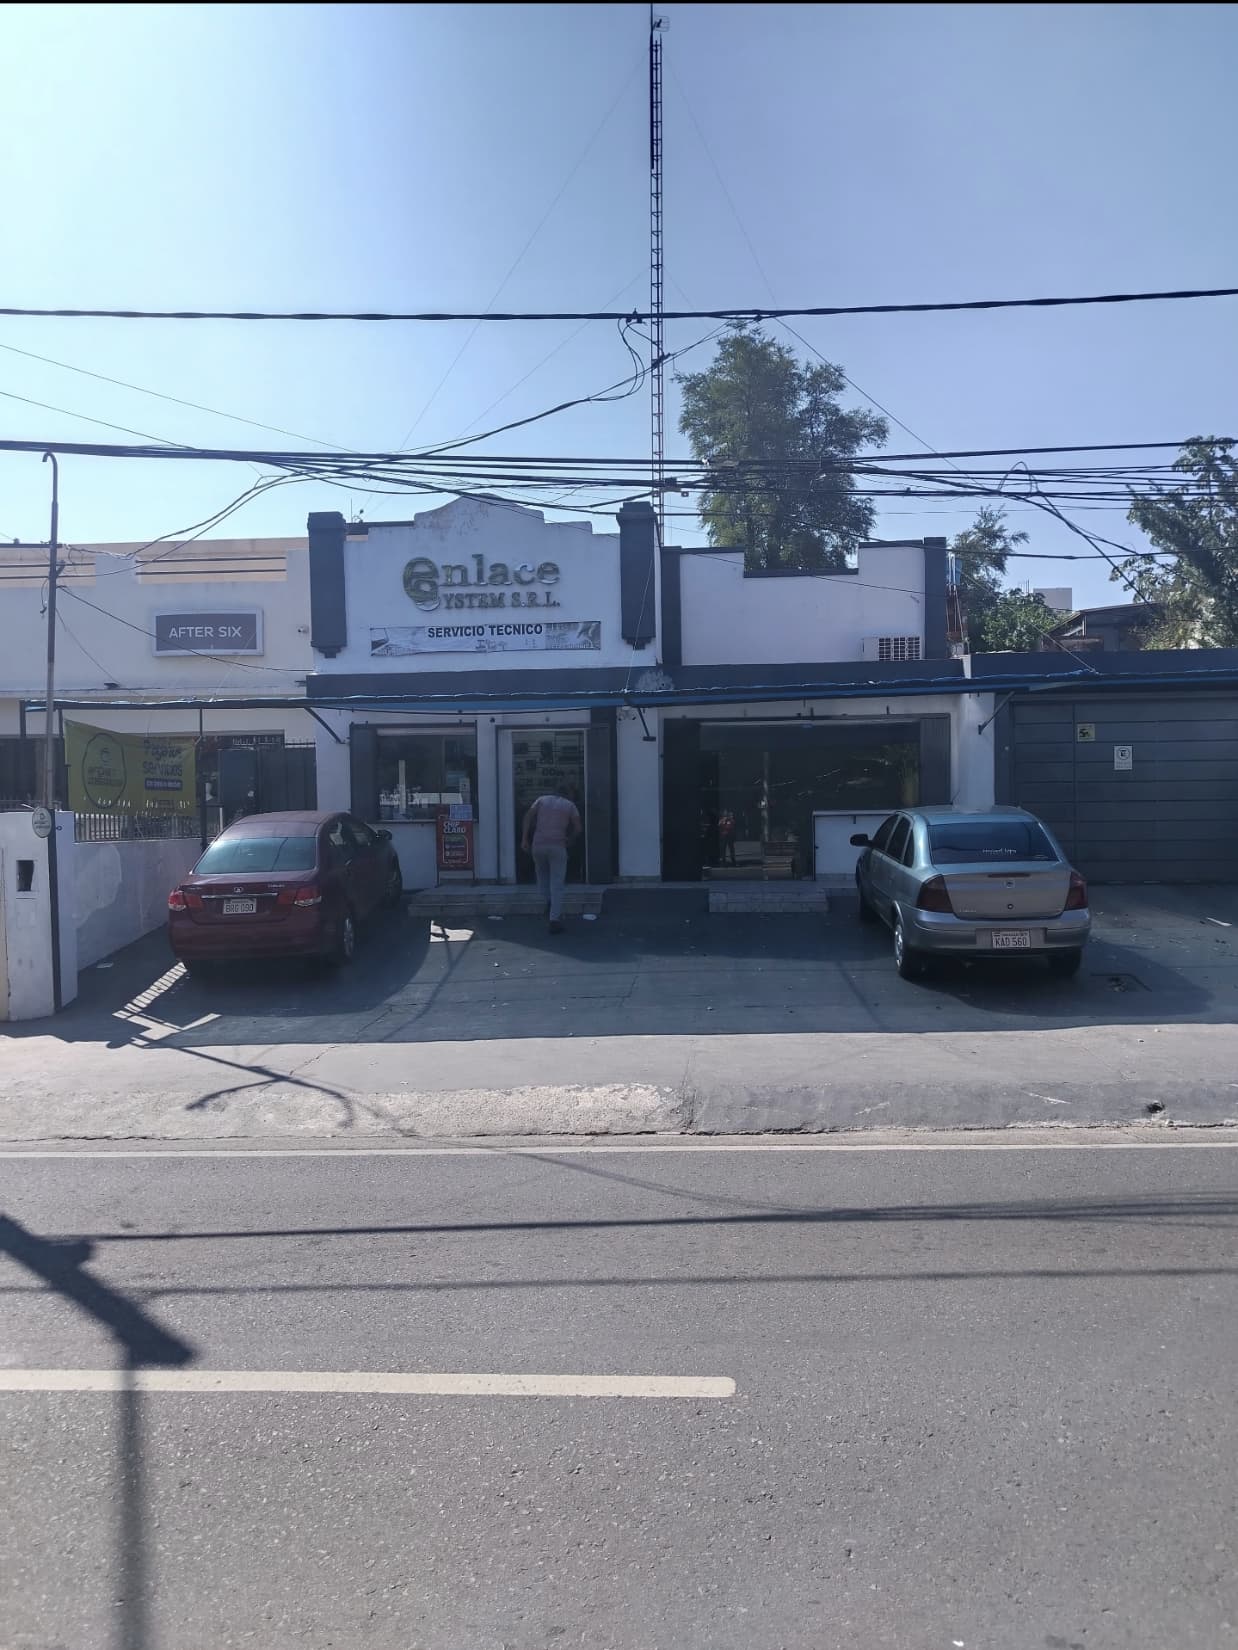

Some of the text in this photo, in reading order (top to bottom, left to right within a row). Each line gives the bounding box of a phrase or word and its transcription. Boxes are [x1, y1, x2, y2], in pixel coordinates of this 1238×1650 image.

[168, 625, 242, 639] AFTER SIX
[427, 626, 485, 638] SERVICIO
[487, 623, 543, 636] TECNICO
